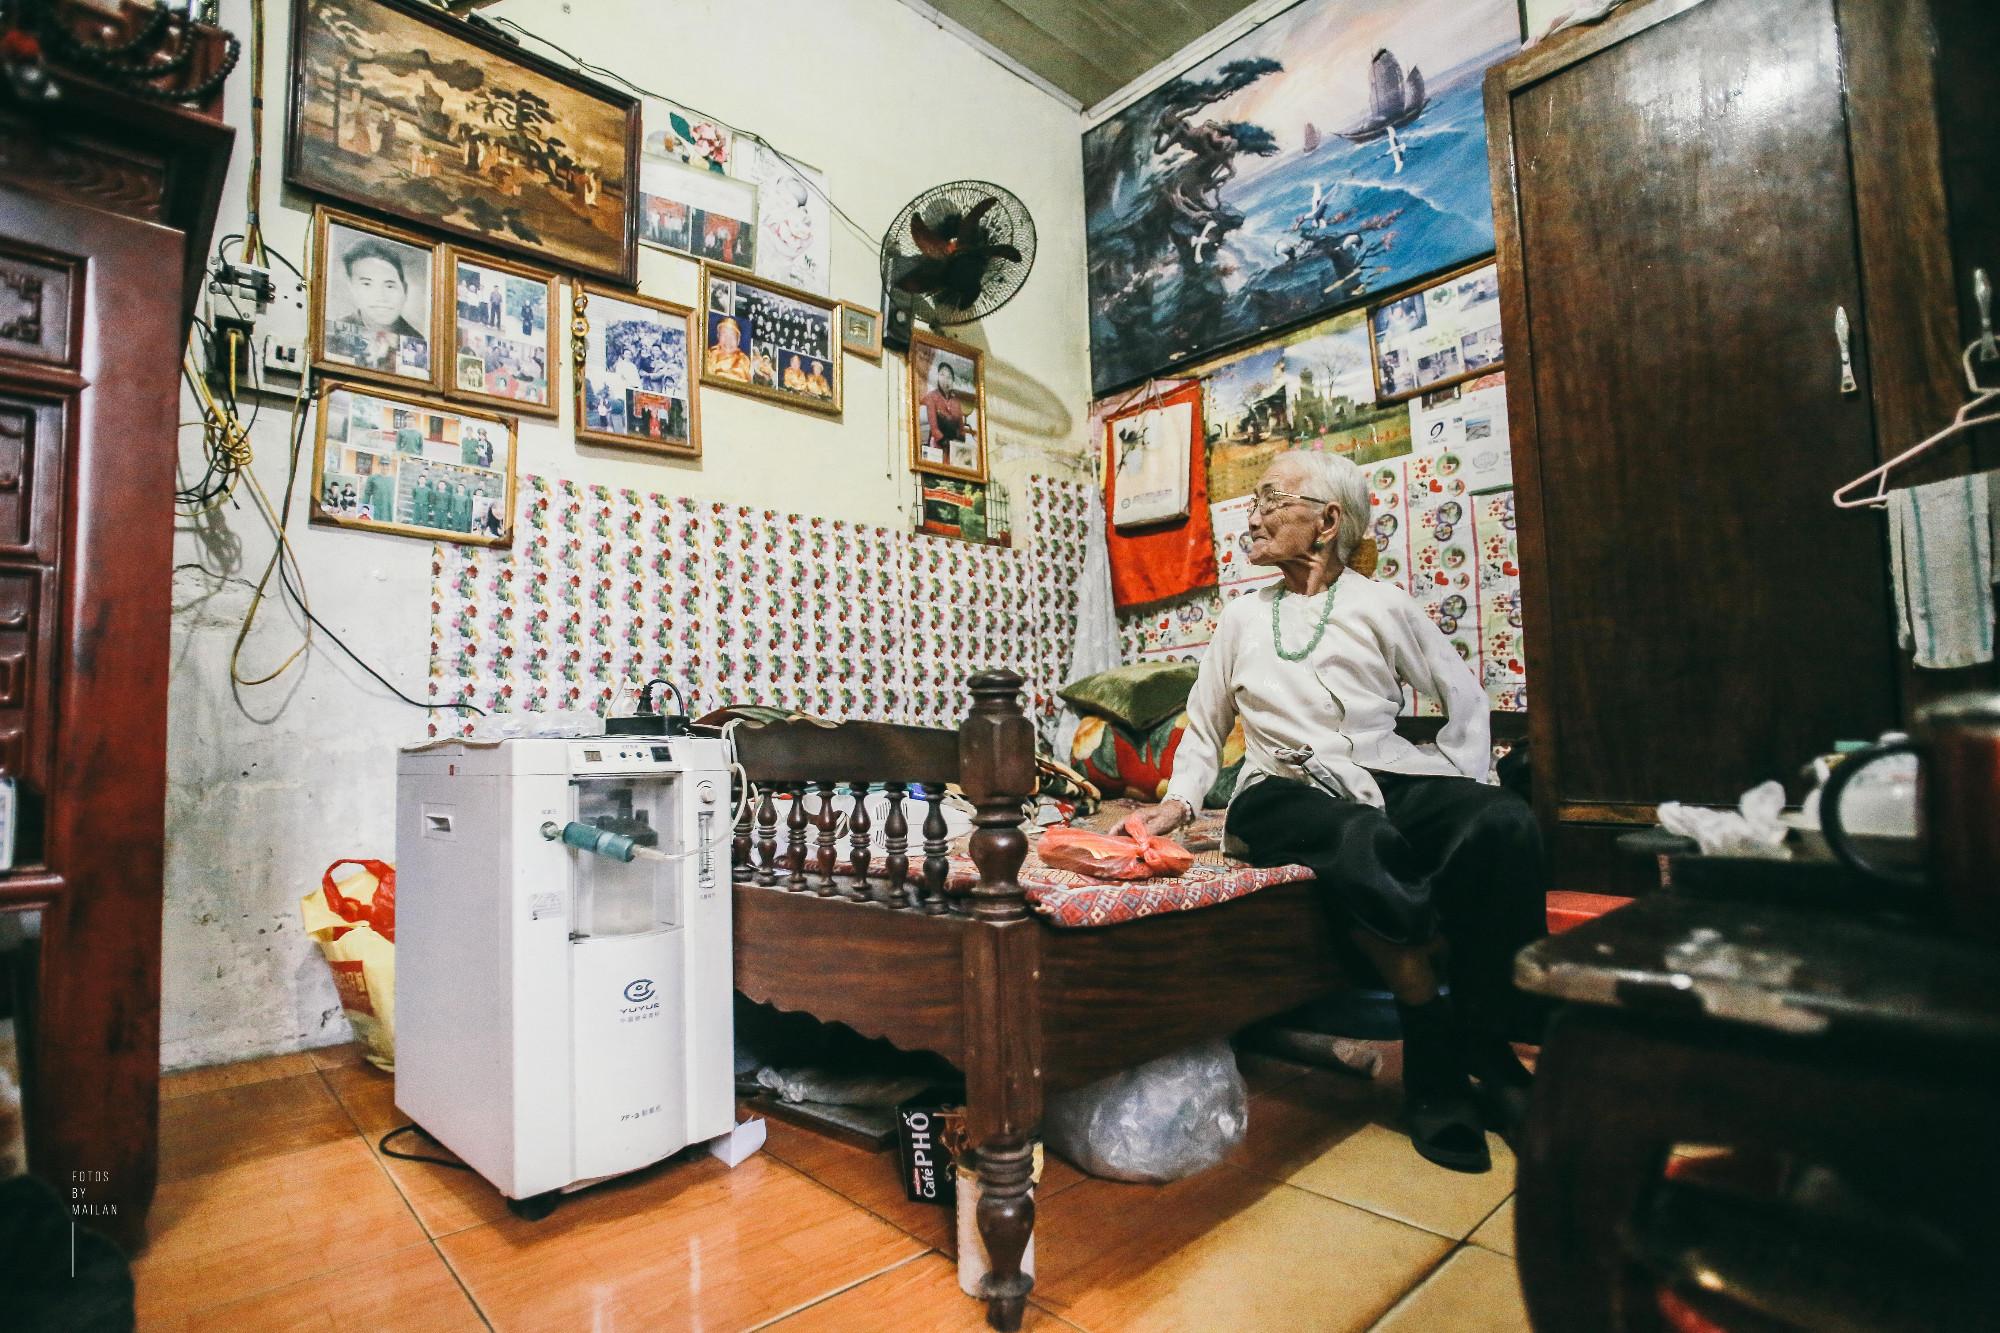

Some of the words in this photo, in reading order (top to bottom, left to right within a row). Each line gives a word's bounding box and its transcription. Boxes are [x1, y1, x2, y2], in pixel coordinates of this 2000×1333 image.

[620, 1003, 660, 1014] YUYUE
[903, 1111, 933, 1167] PHỐ
[921, 1168, 936, 1198] Café
